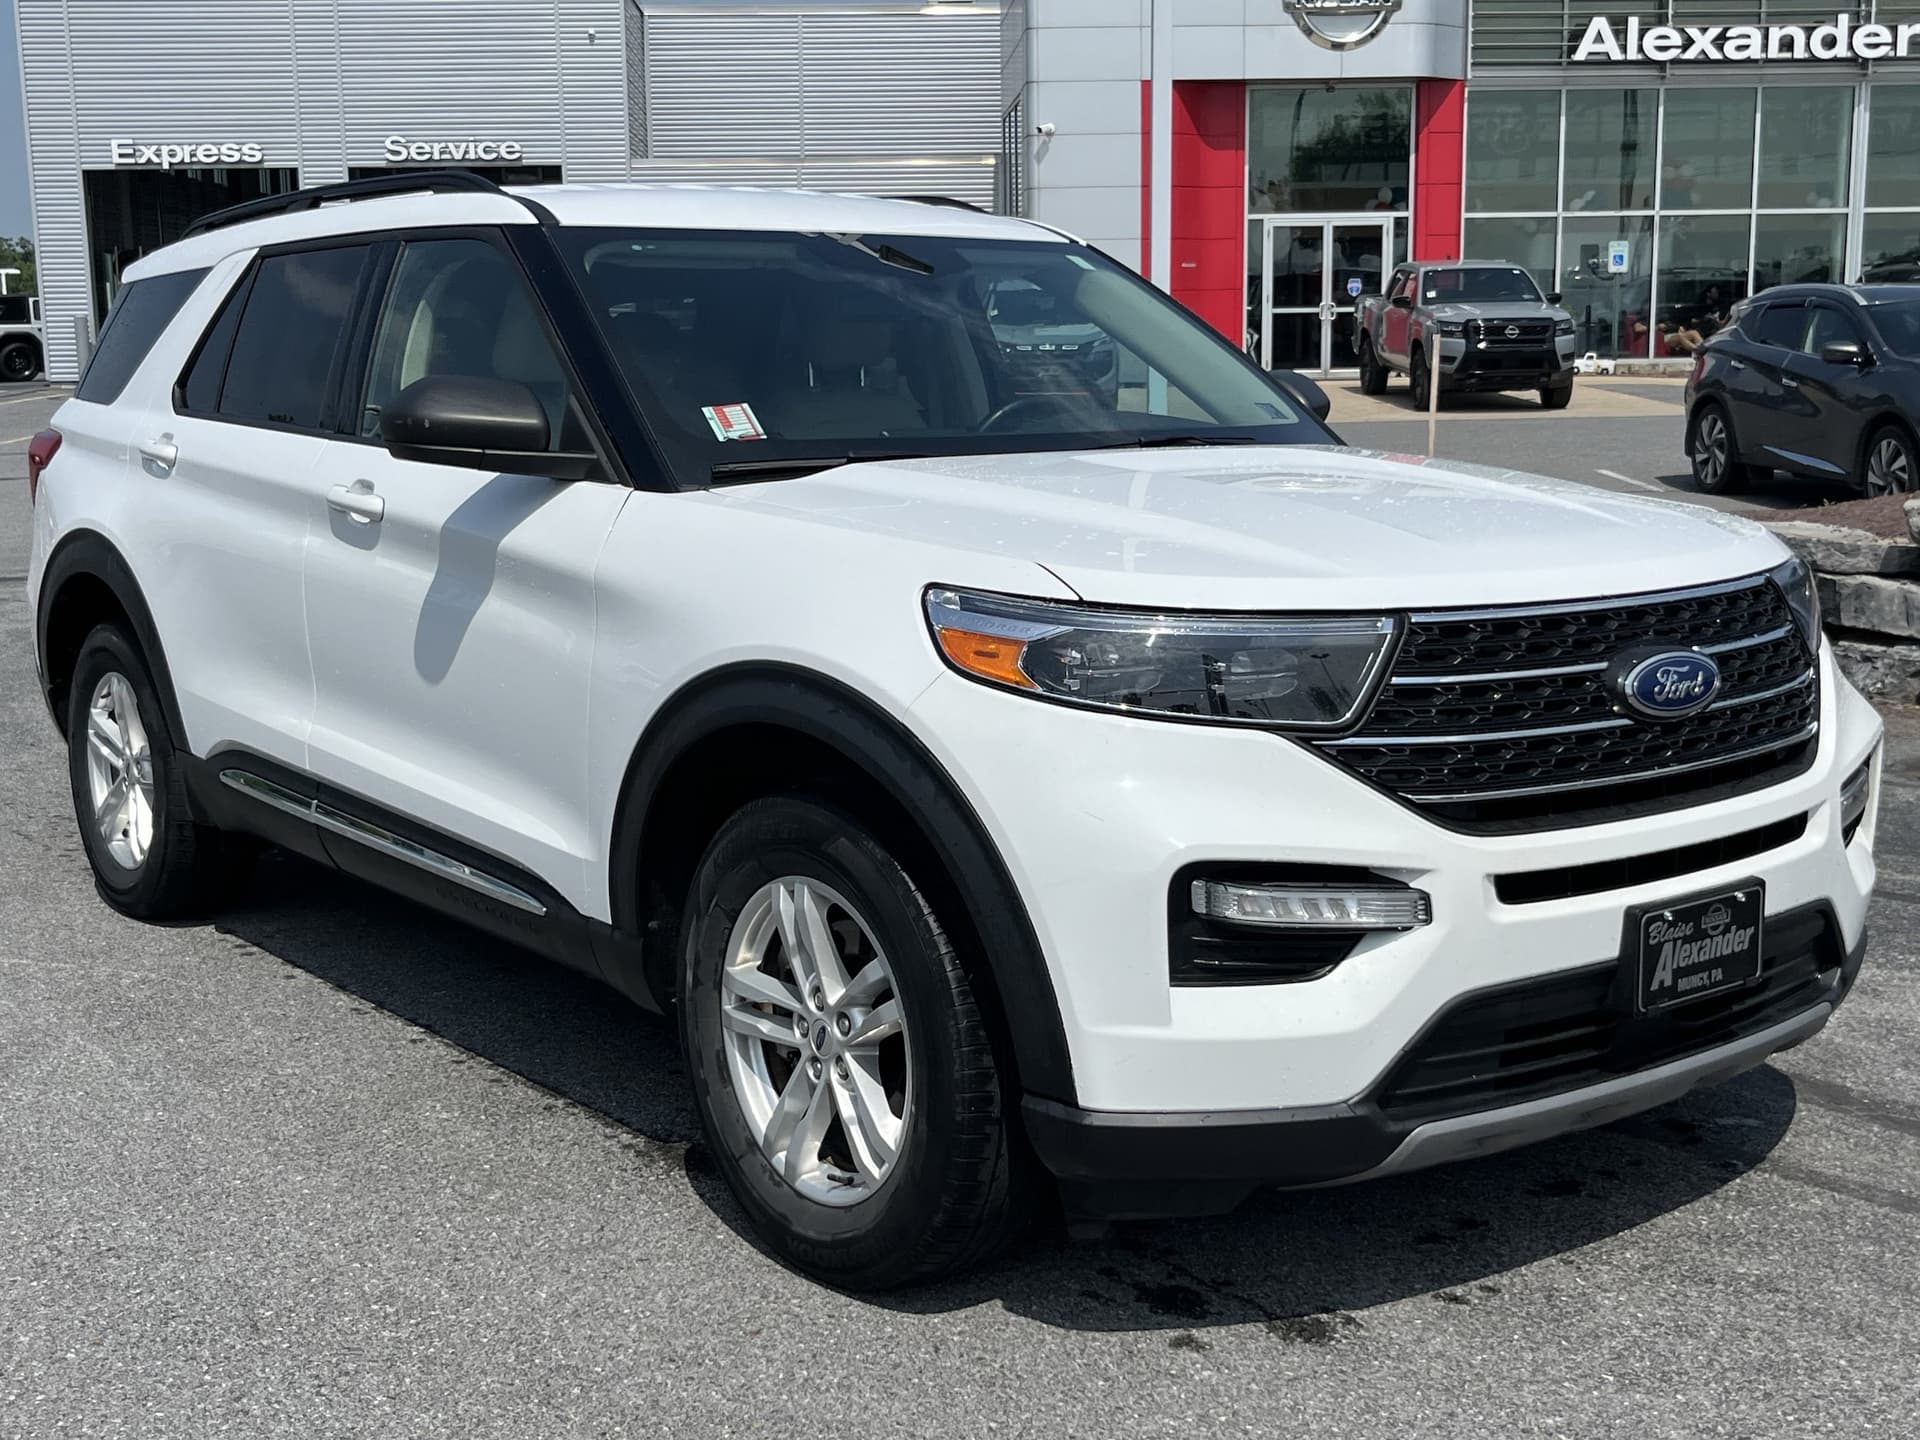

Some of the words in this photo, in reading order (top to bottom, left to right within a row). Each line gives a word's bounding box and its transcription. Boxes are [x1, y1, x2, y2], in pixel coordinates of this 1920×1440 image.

[1573, 13, 1920, 61] Alexander
[110, 138, 264, 170] Express
[384, 135, 523, 162] Service
[1654, 665, 1704, 702] Ford
[1648, 921, 1694, 945] Blaise
[1650, 925, 1755, 991] Alexander
[1711, 967, 1723, 983] PA
